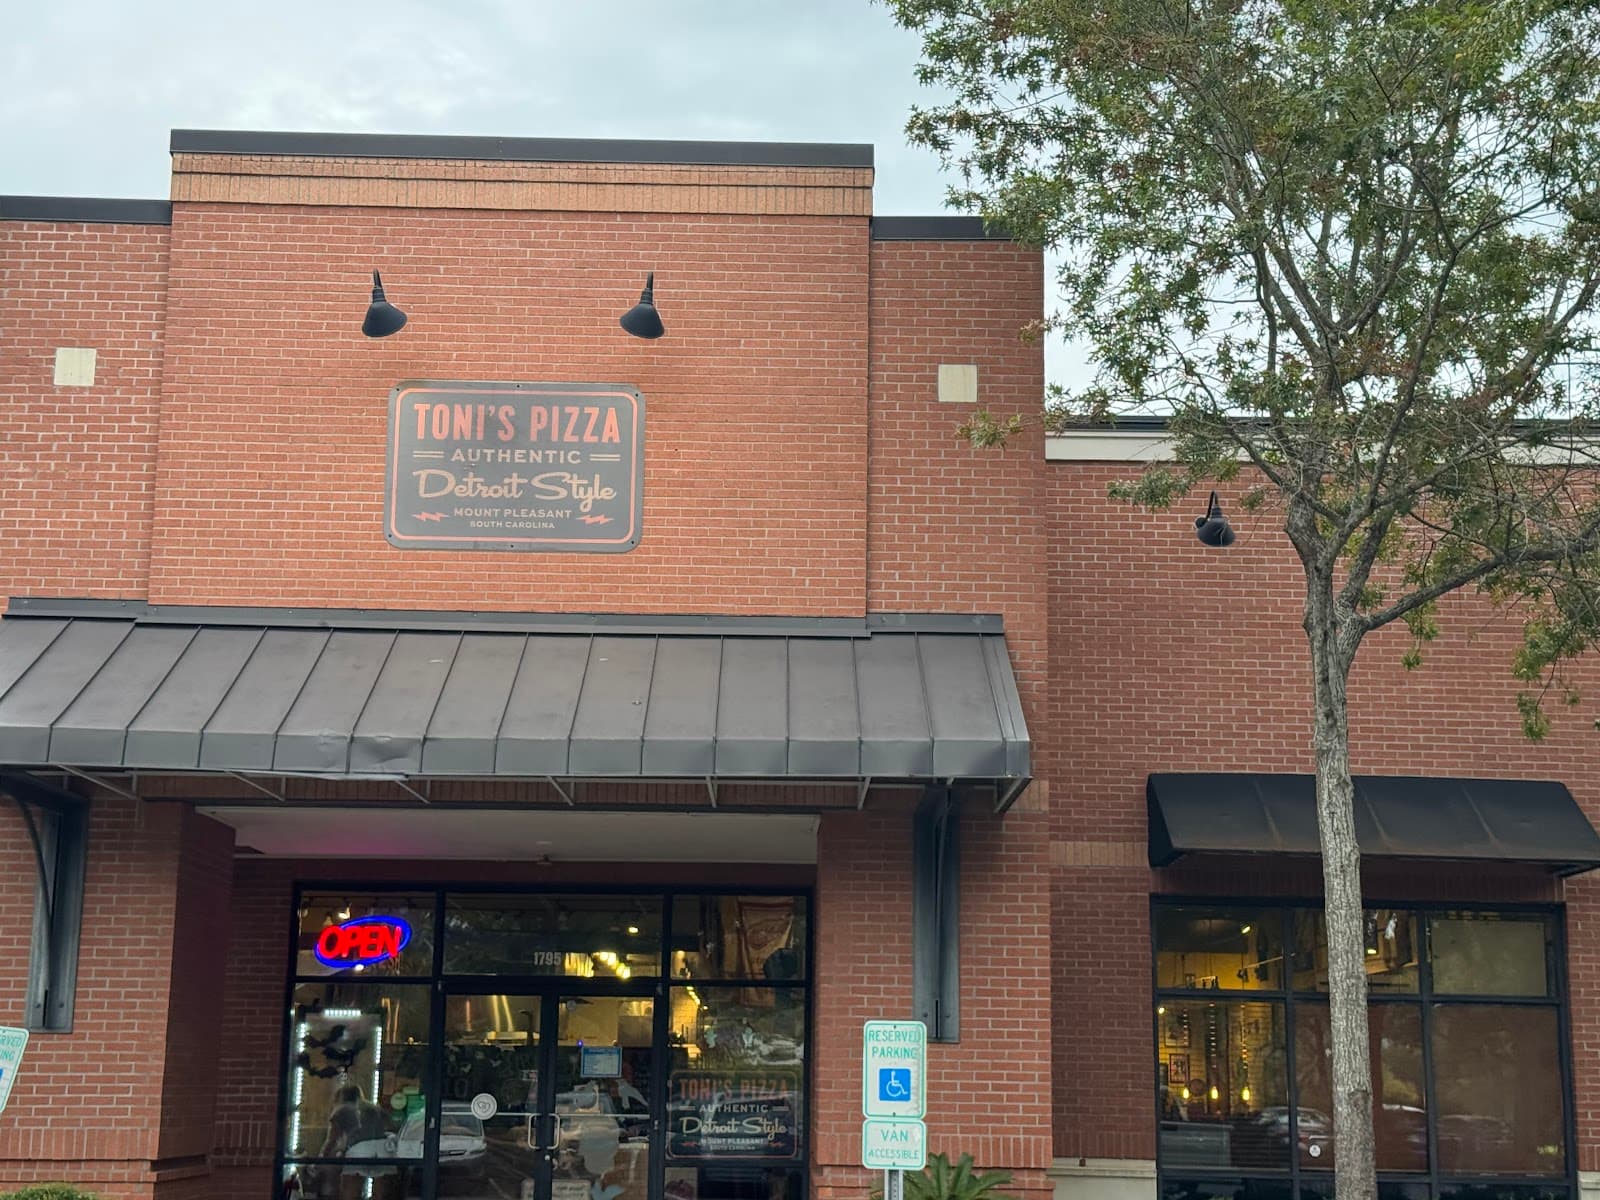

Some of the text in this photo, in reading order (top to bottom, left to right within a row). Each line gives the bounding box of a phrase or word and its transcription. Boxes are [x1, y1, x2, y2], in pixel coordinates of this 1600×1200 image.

[414, 403, 621, 444] TONI'S PIZZA
[451, 448, 582, 464] AUTHENTIC
[412, 468, 617, 513] Detroit Style
[454, 508, 572, 519] MOUNT PLEASANT
[470, 520, 555, 529] SOUTH CAROLINA
[318, 925, 402, 959] OPEN
[534, 951, 562, 966] 1795
[868, 1030, 921, 1043] RESERVED
[872, 1047, 918, 1059] PARKING
[680, 1078, 789, 1100] TONI'S PIZZA
[699, 1104, 769, 1113] AUTHENTIC
[679, 1116, 787, 1141] Detroit Style
[881, 1129, 909, 1142] VAN
[868, 1150, 919, 1160] ACCESSIBLE
